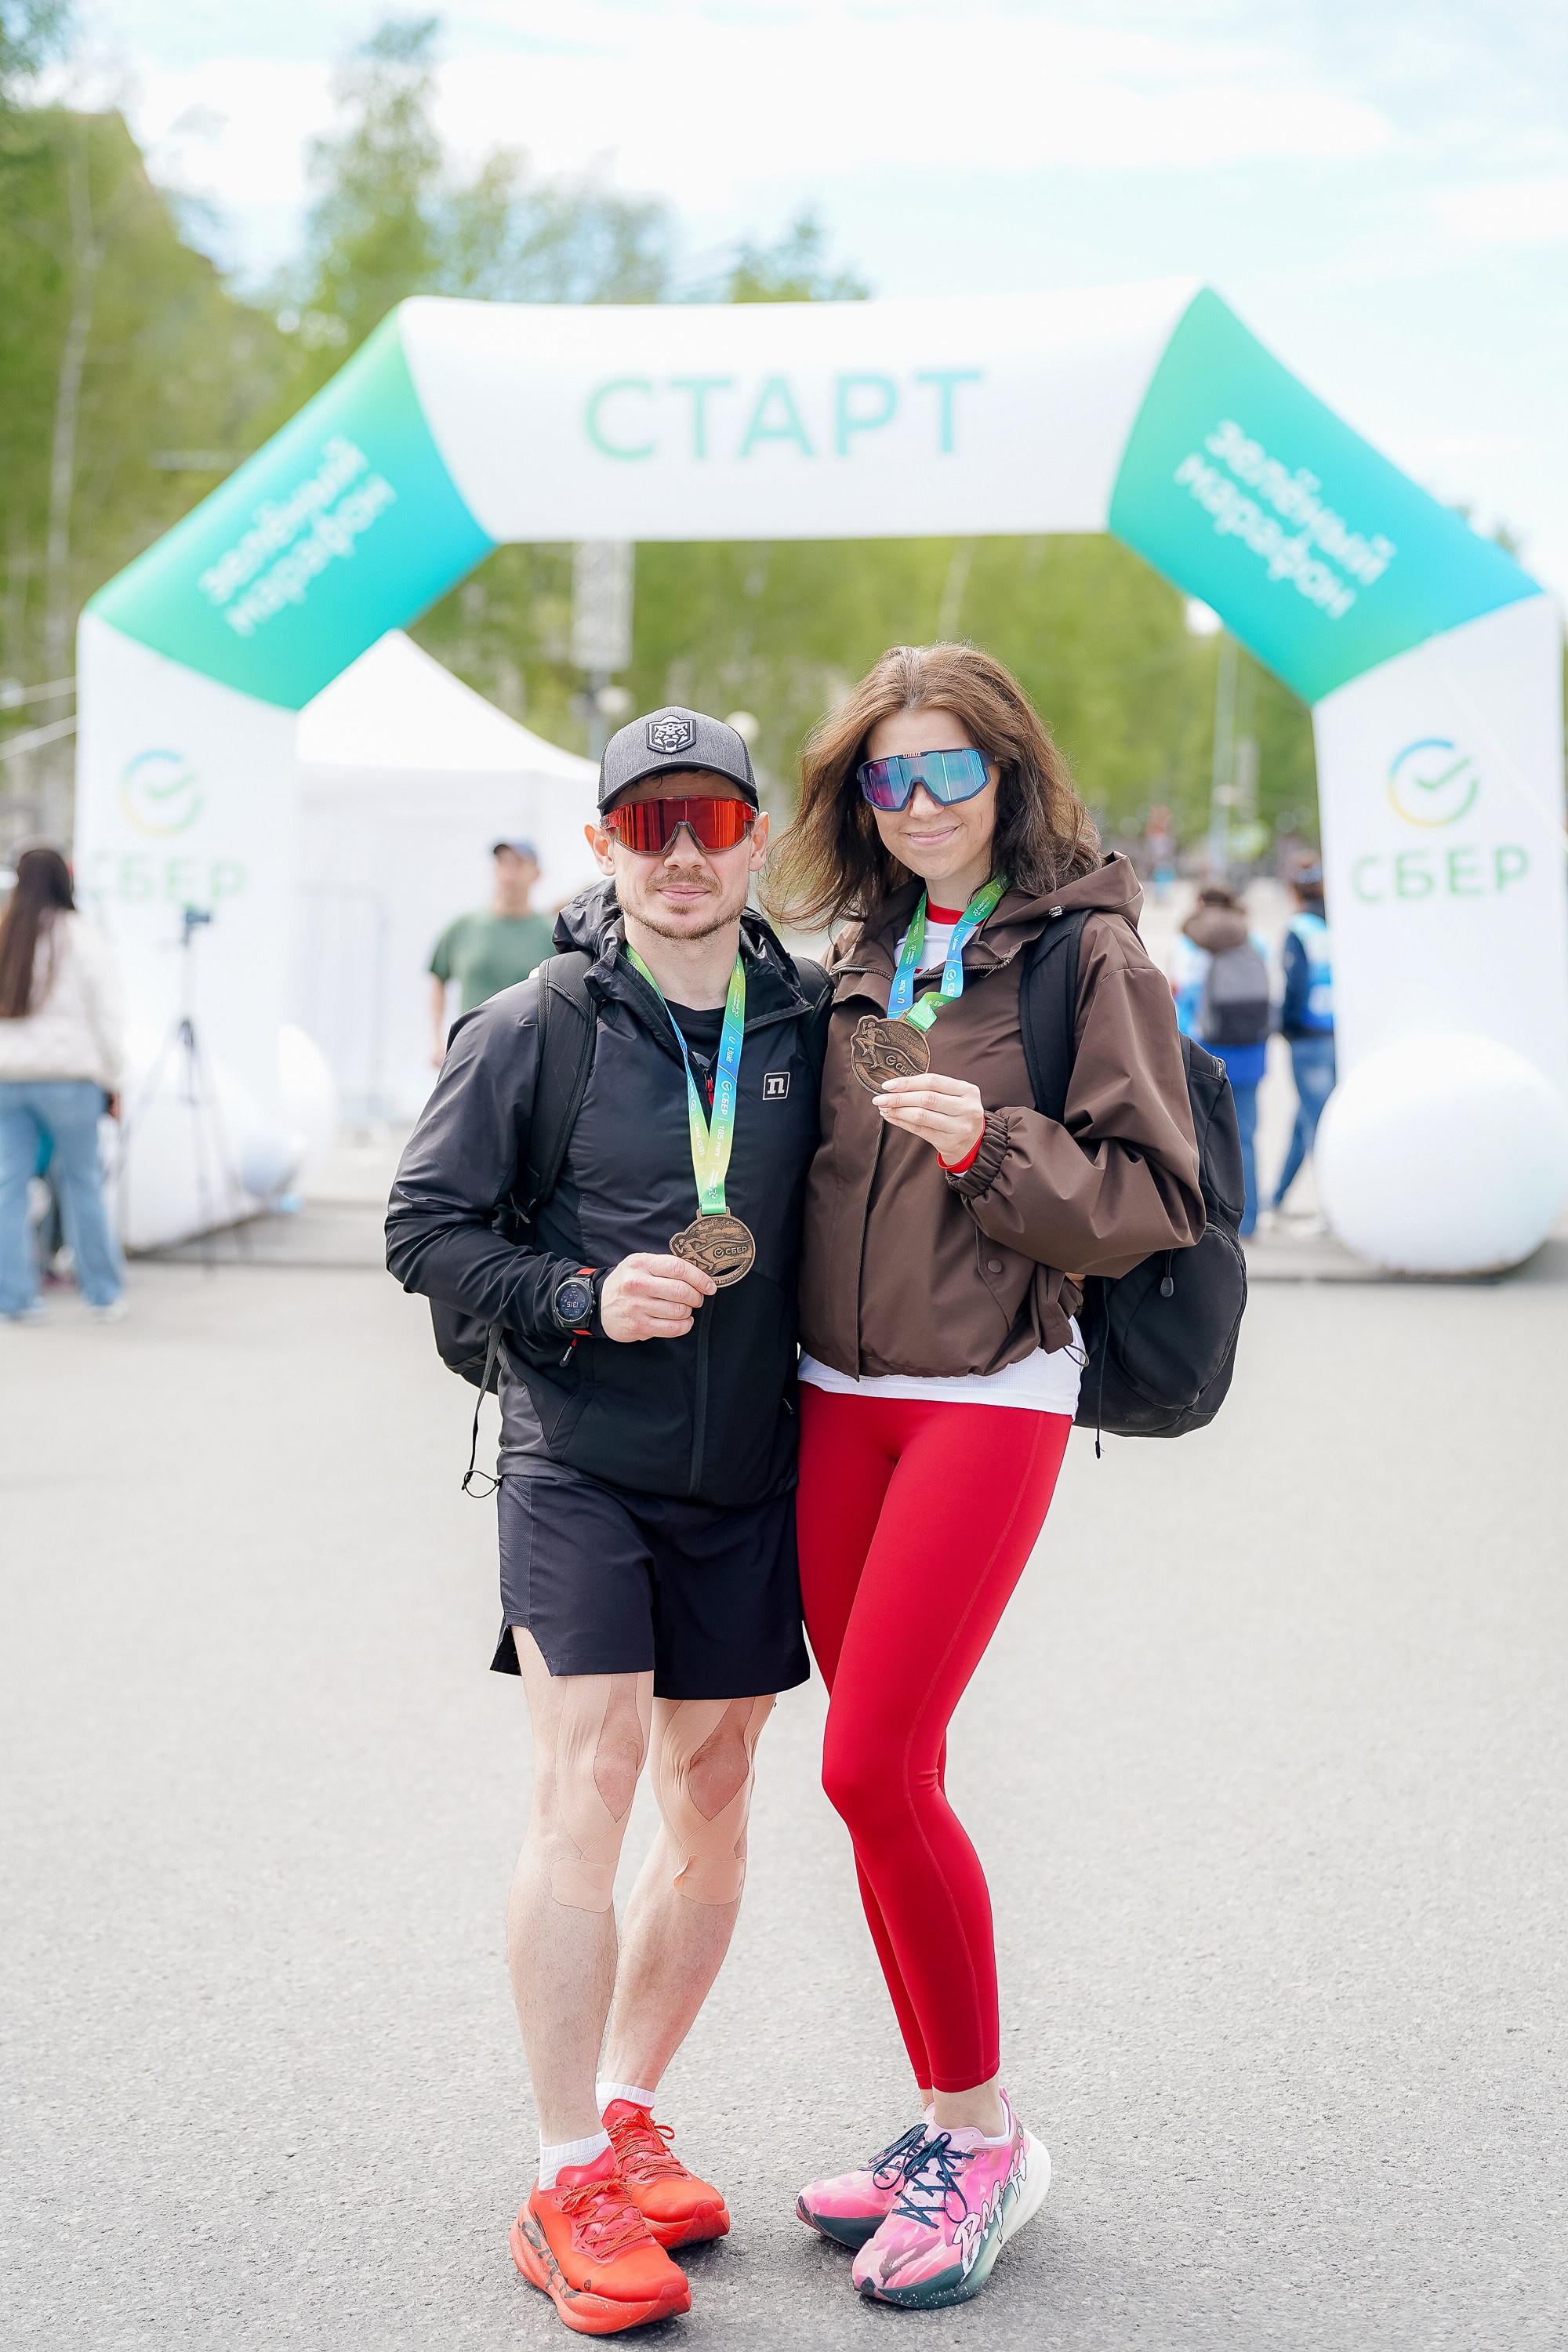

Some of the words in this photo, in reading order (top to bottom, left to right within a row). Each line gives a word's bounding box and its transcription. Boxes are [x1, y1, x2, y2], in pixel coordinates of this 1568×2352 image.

[584, 370, 982, 460] СТАРТ
[1204, 419, 1398, 586] зелёный
[1173, 452, 1358, 620] марафон
[1350, 844, 1531, 905] СБЕР
[725, 1047, 735, 1064] Utair
[720, 1092, 730, 1116] СБЕР
[717, 1125, 725, 1140] 185
[725, 1246, 748, 1254] СБЕР
